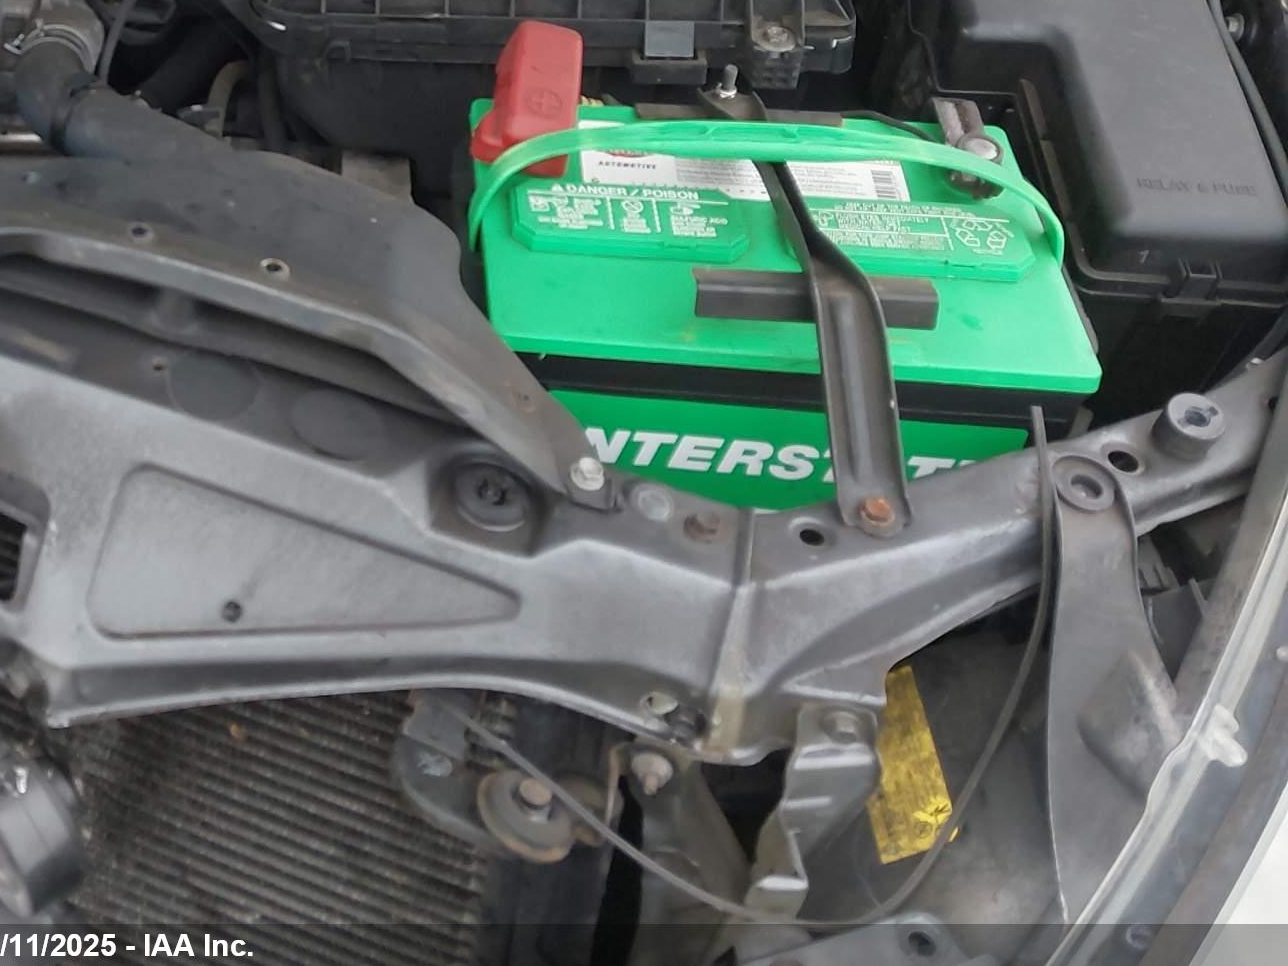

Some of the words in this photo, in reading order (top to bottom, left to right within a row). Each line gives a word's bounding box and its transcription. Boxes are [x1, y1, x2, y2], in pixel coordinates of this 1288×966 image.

[598, 160, 657, 170] AUTOMOTIVE
[566, 183, 628, 197] DANGER
[642, 188, 700, 201] POISON
